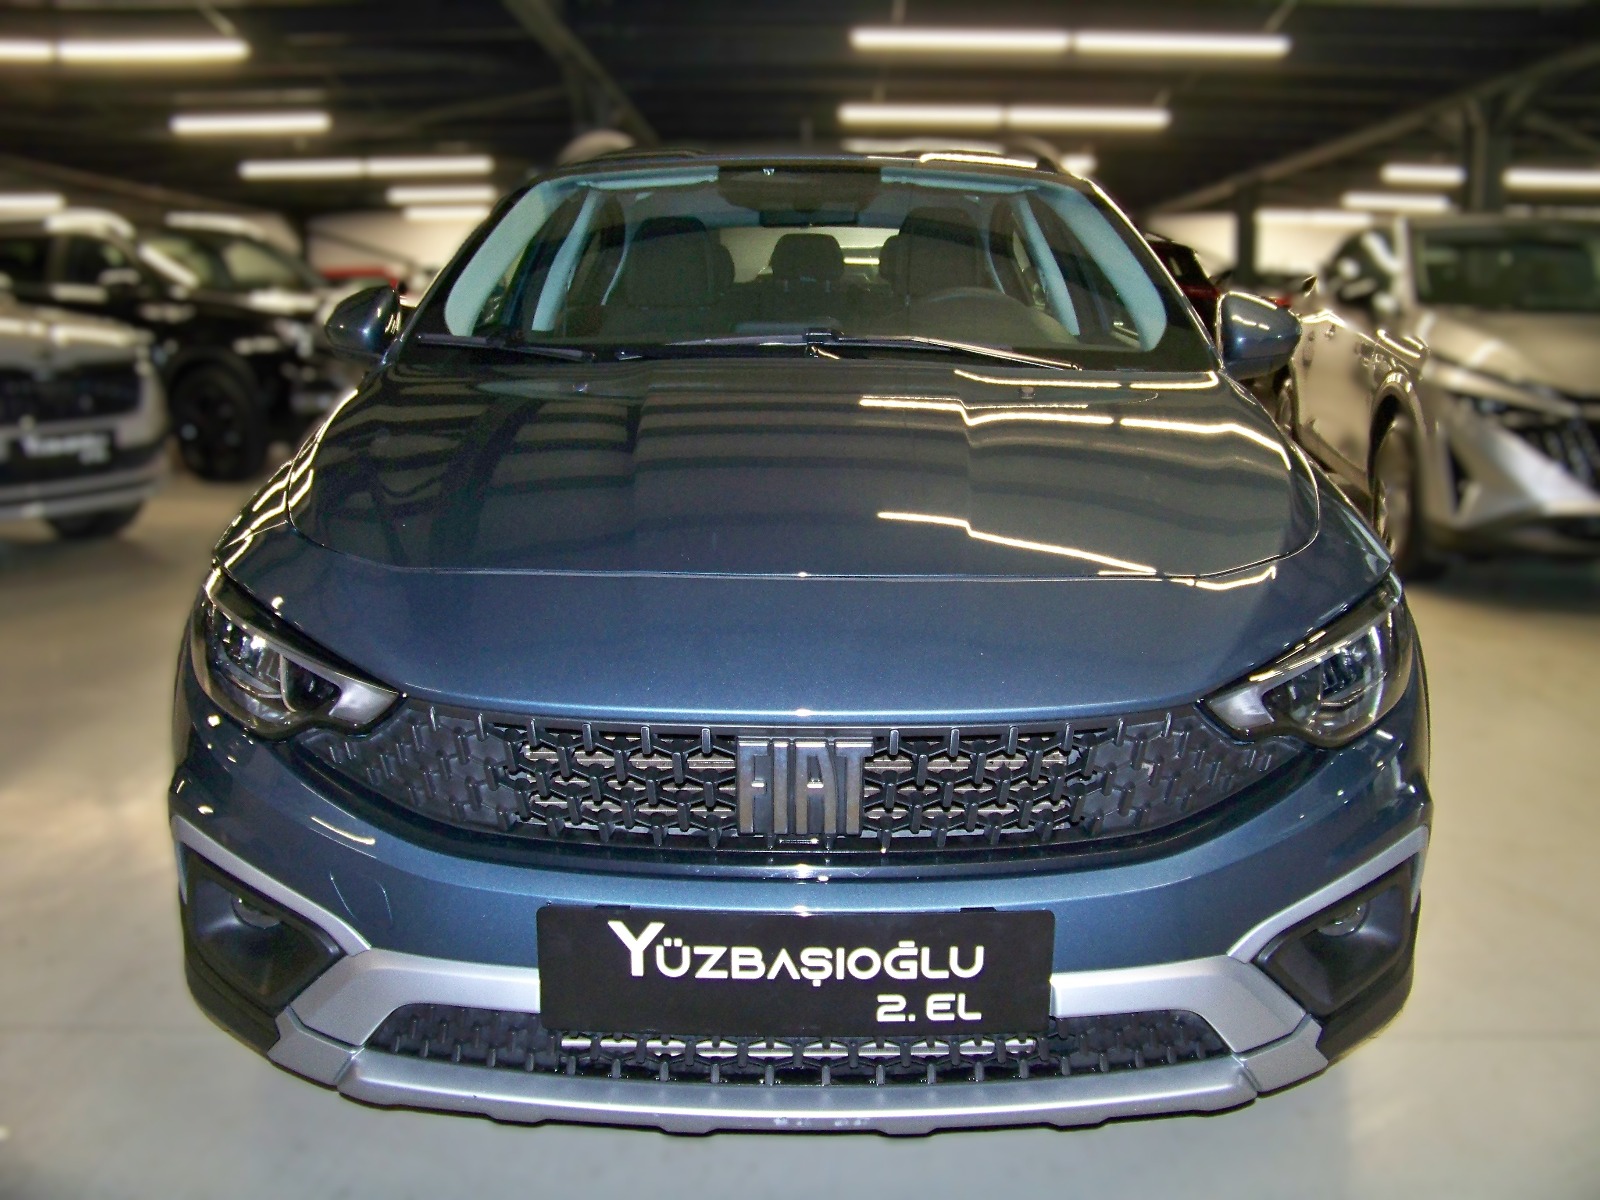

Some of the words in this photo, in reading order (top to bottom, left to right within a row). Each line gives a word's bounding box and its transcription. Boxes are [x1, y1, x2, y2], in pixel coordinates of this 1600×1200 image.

[737, 741, 874, 835] FIAT
[876, 994, 916, 1022] 2.
[926, 993, 982, 1021] EL
